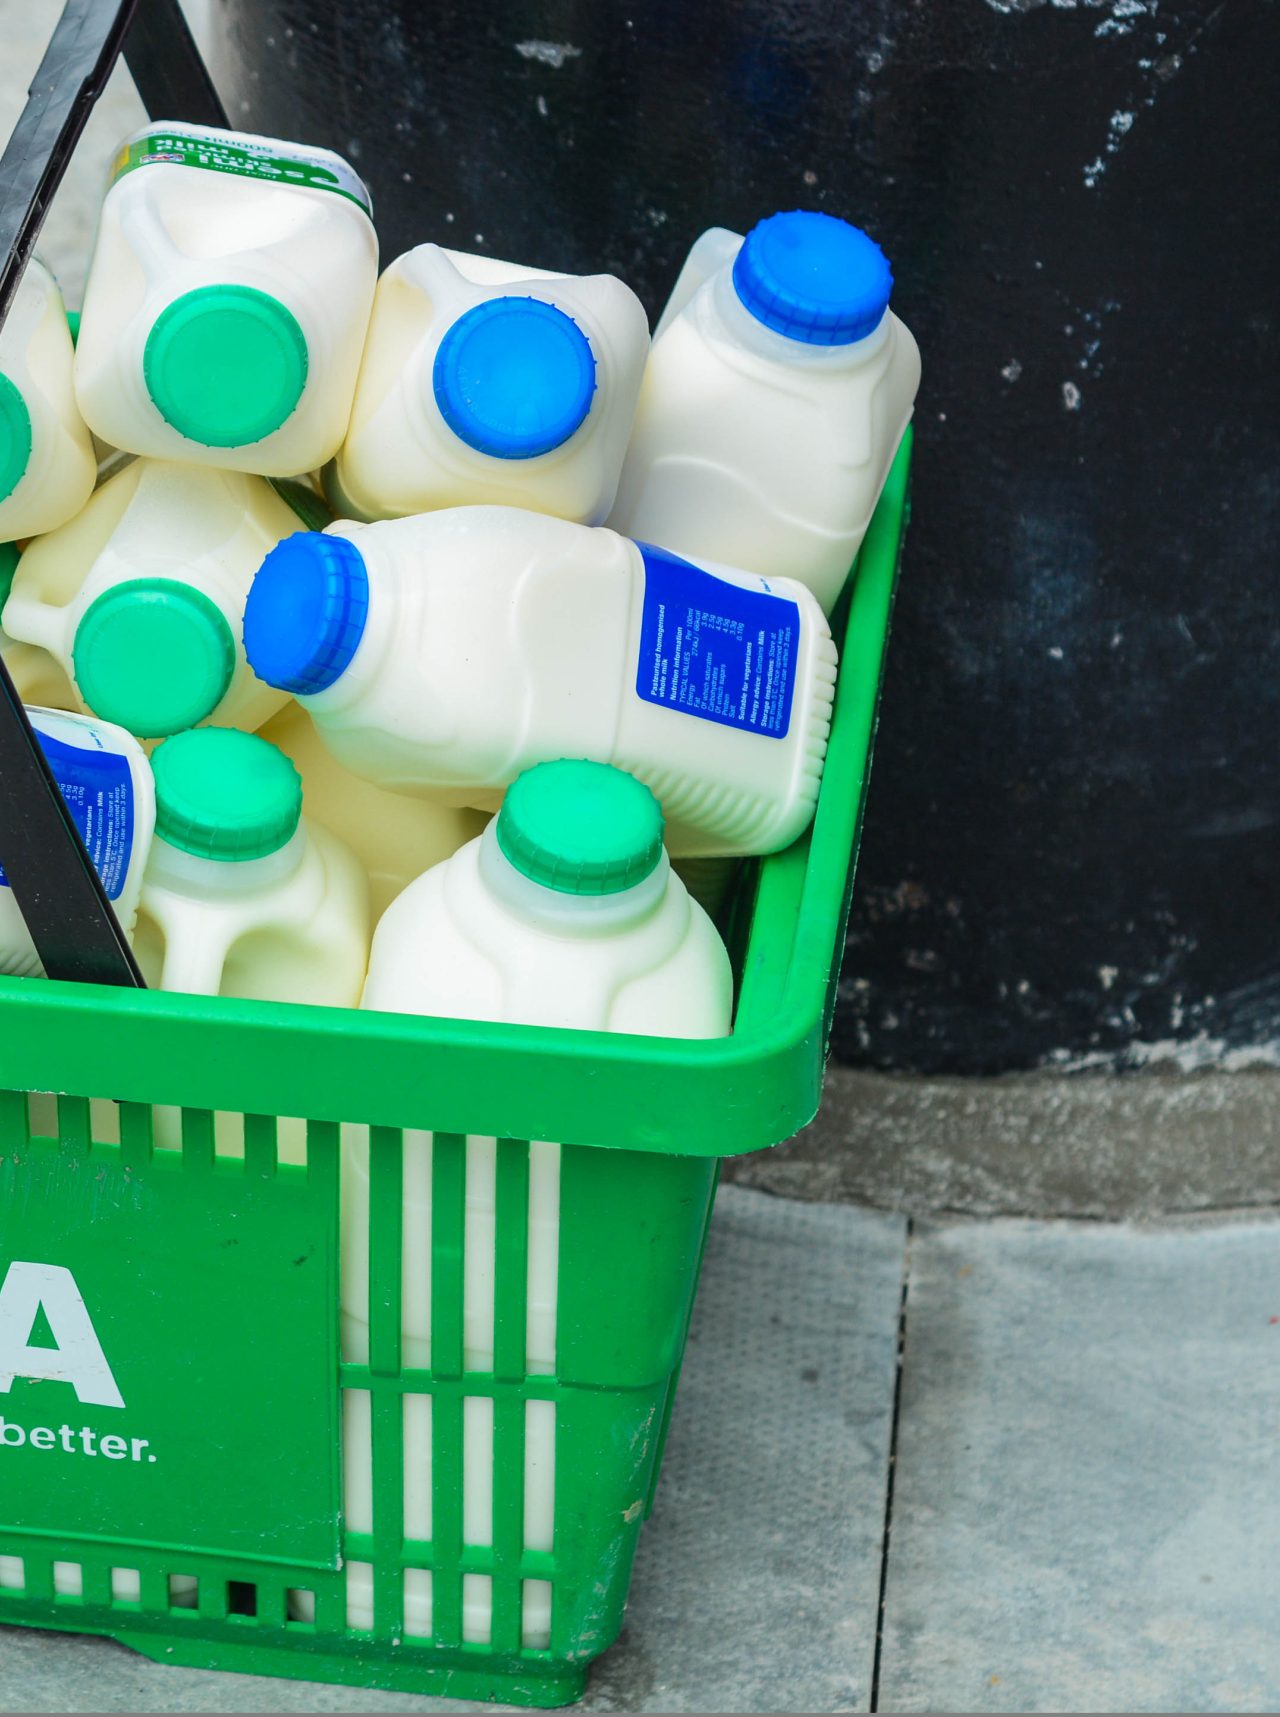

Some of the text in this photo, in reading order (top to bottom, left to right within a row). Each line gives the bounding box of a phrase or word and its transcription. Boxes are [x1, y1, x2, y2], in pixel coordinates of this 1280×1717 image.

[651, 604, 665, 696] Pasteurised homogenised
[671, 626, 683, 701] Nutrition information
[739, 692, 747, 720] Suitable
[85, 805, 93, 846] vegetarians
